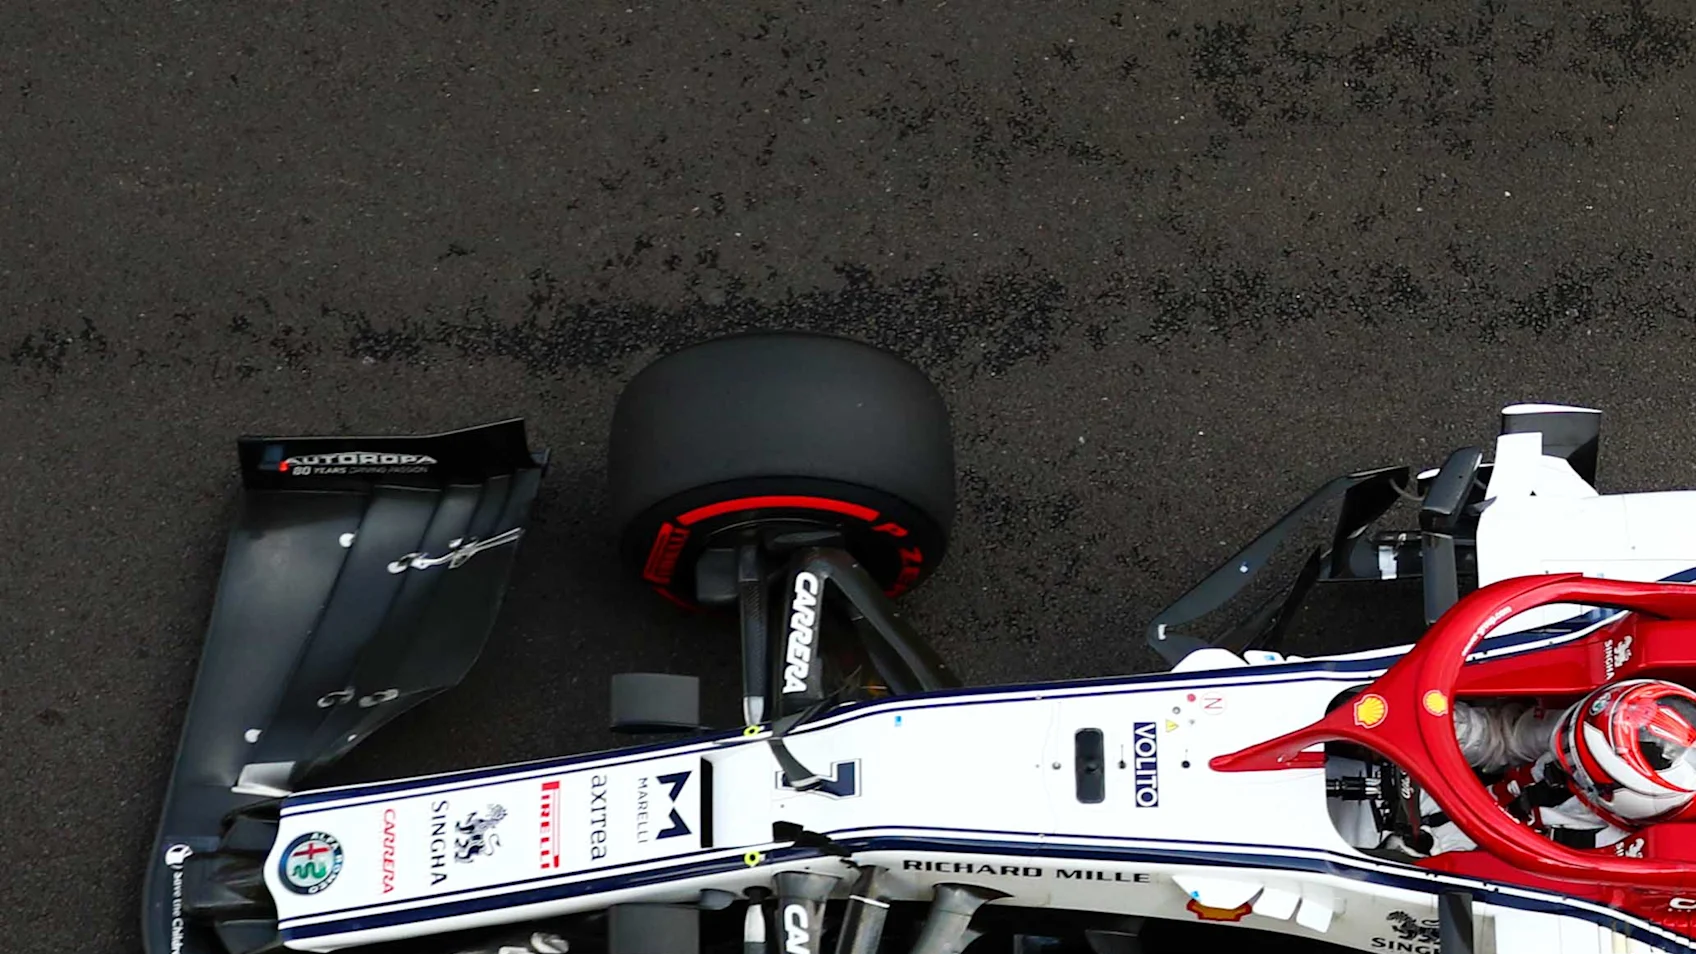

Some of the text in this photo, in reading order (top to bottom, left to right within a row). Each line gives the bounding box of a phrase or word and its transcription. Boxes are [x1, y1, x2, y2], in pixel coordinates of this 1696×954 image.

[285, 451, 438, 465] AUTOROPA
[782, 571, 819, 694] CARRERA
[1603, 638, 1615, 681] SINGHA
[1134, 722, 1158, 808] VOLITO
[382, 808, 397, 895] CARRERA
[430, 800, 449, 887] SINGHA
[540, 780, 561, 869] PIRELLI
[636, 777, 649, 844] MARELLI
[902, 859, 1152, 883] RICHARD MILLE
